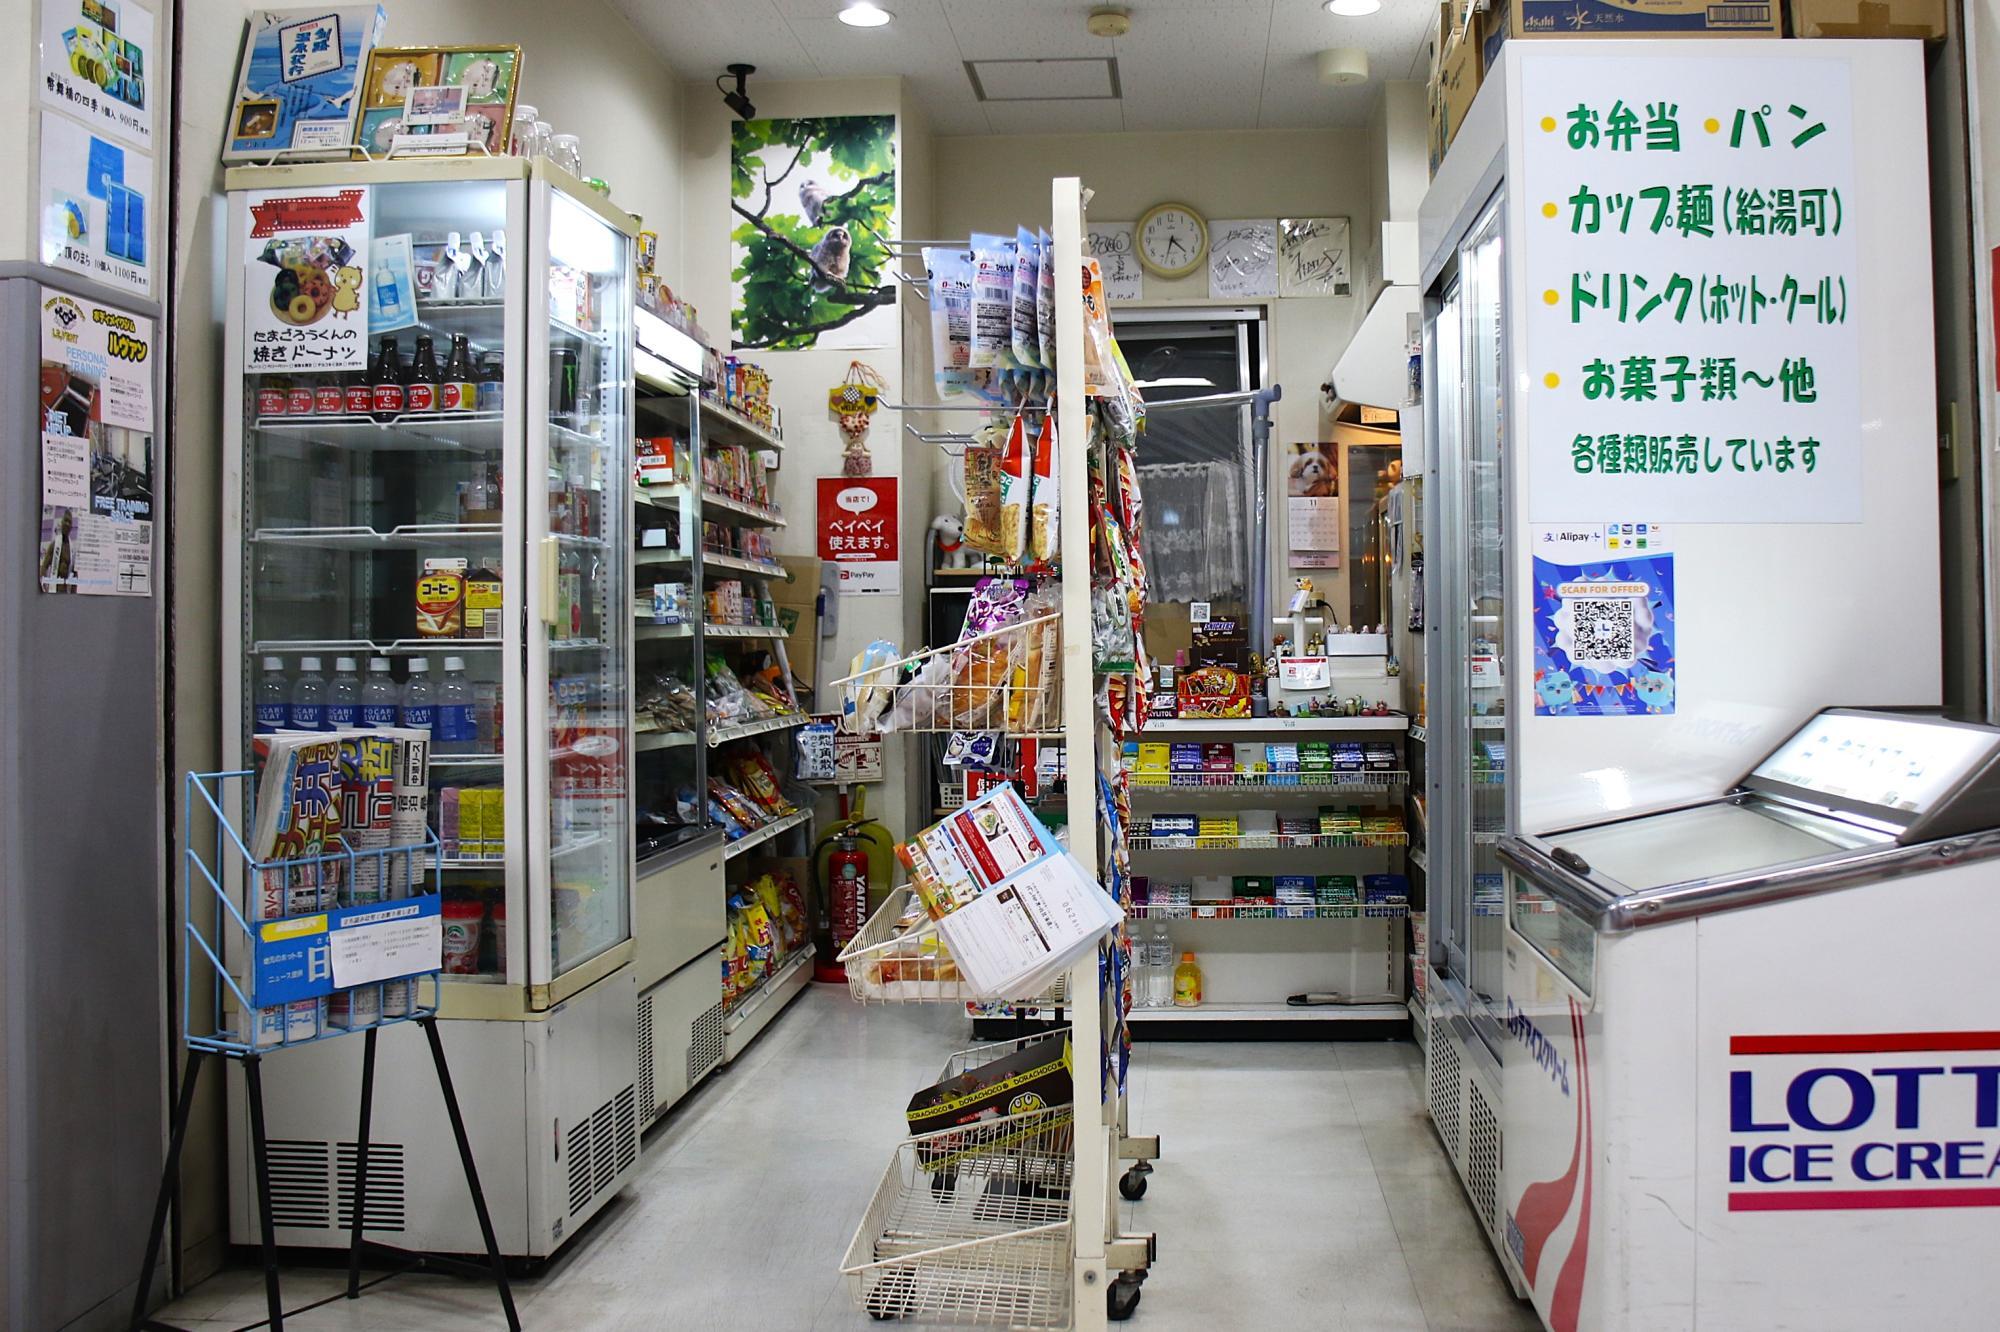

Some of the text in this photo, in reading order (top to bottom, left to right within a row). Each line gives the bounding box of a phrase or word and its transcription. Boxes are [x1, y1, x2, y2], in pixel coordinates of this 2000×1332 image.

[1525, 16, 1554, 27] Asahi
[1595, 13, 1625, 24] 天然水
[1567, 100, 1827, 152] お弁当 パン
[1568, 184, 1843, 238] カップ麺(給湯可)
[1571, 271, 1847, 325] ドリンク(ホット・クール)
[254, 329, 357, 342] たまごろうくんの
[66, 346, 108, 367] PERSONAL
[253, 345, 356, 363] 焼きドーナツ
[70, 360, 107, 378] TRAINING
[1571, 433, 1821, 474] 各種類販売しています
[95, 495, 149, 514] FREE TRAINING
[829, 519, 885, 533] ペイペイ
[829, 536, 889, 550] 使えます。
[1560, 532, 1590, 543] Alipay
[850, 571, 875, 579] PayPay
[422, 583, 455, 595] コーヒー
[1561, 585, 1645, 594] SCAN FOR OFFERS
[1012, 1063, 1057, 1084] DORACHOCO
[958, 1085, 1003, 1105] DORACHOCO
[1730, 1065, 2000, 1133] LOTT
[909, 1105, 948, 1120] DORACHOCO
[1729, 1144, 1833, 1183] ICE
